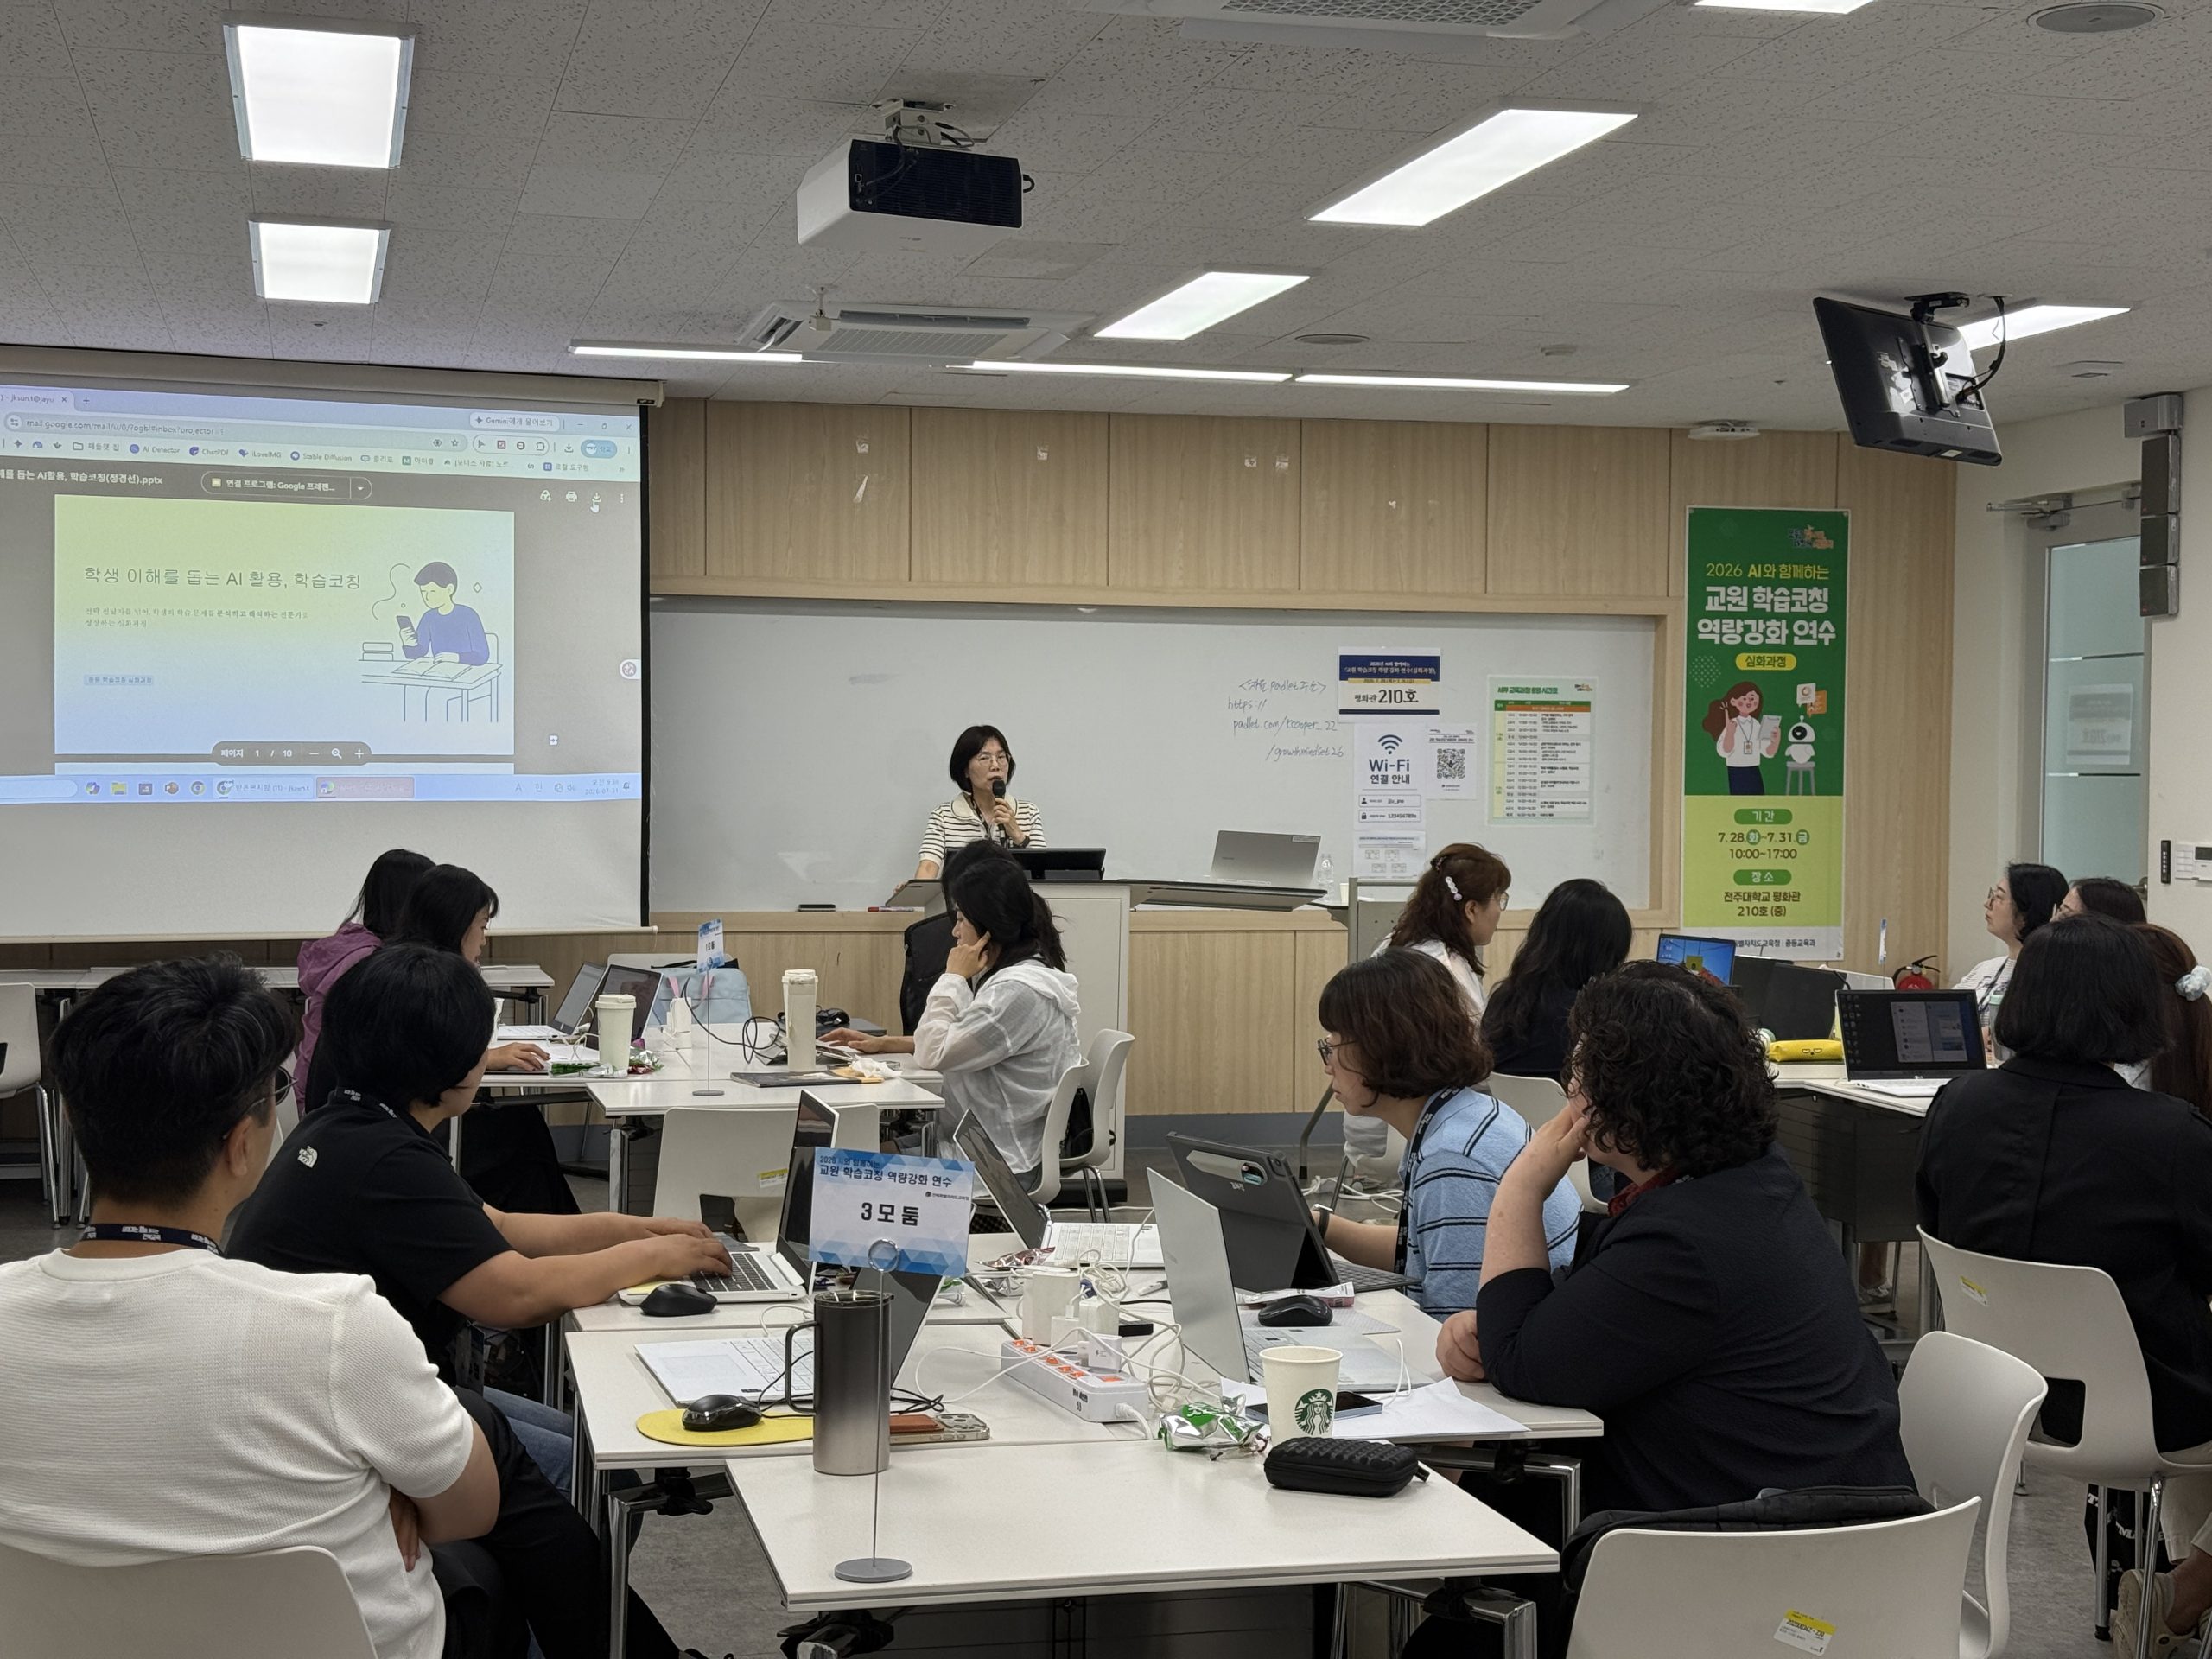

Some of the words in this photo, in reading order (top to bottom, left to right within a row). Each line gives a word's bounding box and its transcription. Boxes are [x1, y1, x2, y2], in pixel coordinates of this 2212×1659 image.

[17, 469, 35, 480] 돕는
[277, 481, 305, 492] Google
[84, 566, 119, 584] 학생
[127, 567, 180, 586] 이해를
[186, 569, 221, 586] 돕는
[226, 571, 243, 586] AI
[248, 570, 289, 589] 활용,
[294, 571, 361, 590] 학습코칭
[1706, 563, 1743, 577] 2026
[1747, 563, 1777, 579] AI와
[1778, 563, 1830, 580] 함께하는
[1705, 585, 1749, 613] 교원
[1752, 585, 1829, 613] 학습코칭
[1697, 618, 1789, 645] 역량강화
[1792, 619, 1837, 646] 연수
[1745, 655, 1787, 668] 심화과정
[1377, 689, 1420, 704] 210호
[220, 748, 244, 758] 페이지
[283, 749, 293, 758] 10
[1369, 759, 1410, 772] Wi-Fi
[1370, 773, 1389, 785] 연결
[1391, 773, 1410, 785] 안내
[1729, 849, 1798, 860] 10:00~17:00
[1723, 891, 1771, 903] 전주대학교
[1772, 892, 1802, 904] 평화관
[1737, 906, 1769, 918] 210호
[1770, 906, 1787, 918] (중)
[819, 1164, 840, 1177] 교원
[842, 1166, 884, 1182] 학습코칭
[887, 1171, 928, 1185] 역량강화
[931, 1174, 952, 1188] 연수
